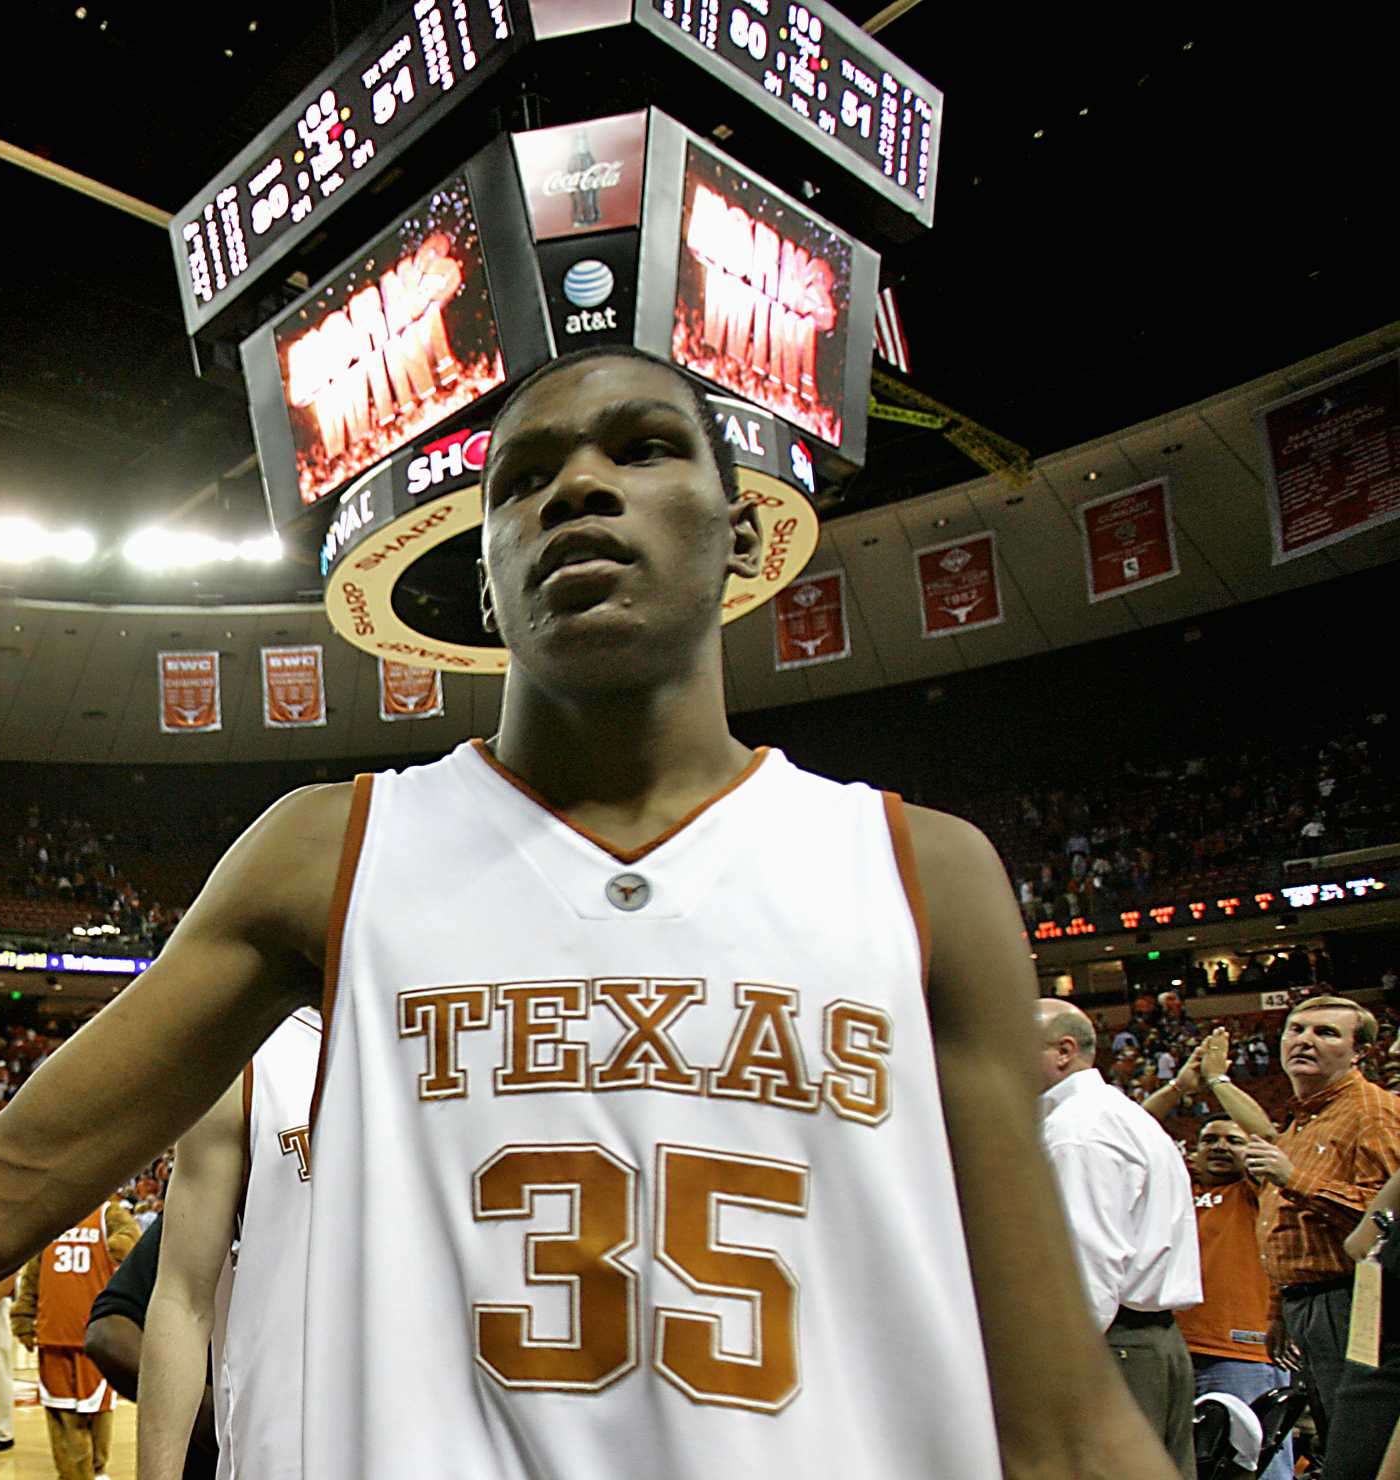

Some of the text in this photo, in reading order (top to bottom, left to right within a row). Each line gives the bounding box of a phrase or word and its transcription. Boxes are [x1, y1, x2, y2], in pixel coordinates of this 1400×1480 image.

[729, 8, 767, 60] 80
[788, 4, 822, 42] 100
[372, 66, 414, 125] 51
[840, 89, 872, 138] 51
[252, 183, 289, 235] 80
[565, 307, 618, 334] at&t
[354, 505, 453, 571] SHARP
[762, 517, 798, 582] SHARP
[343, 582, 375, 637] SHARP
[398, 976, 894, 1128] TEXAS
[53, 1244, 91, 1273] 30
[472, 1142, 810, 1416] 35
